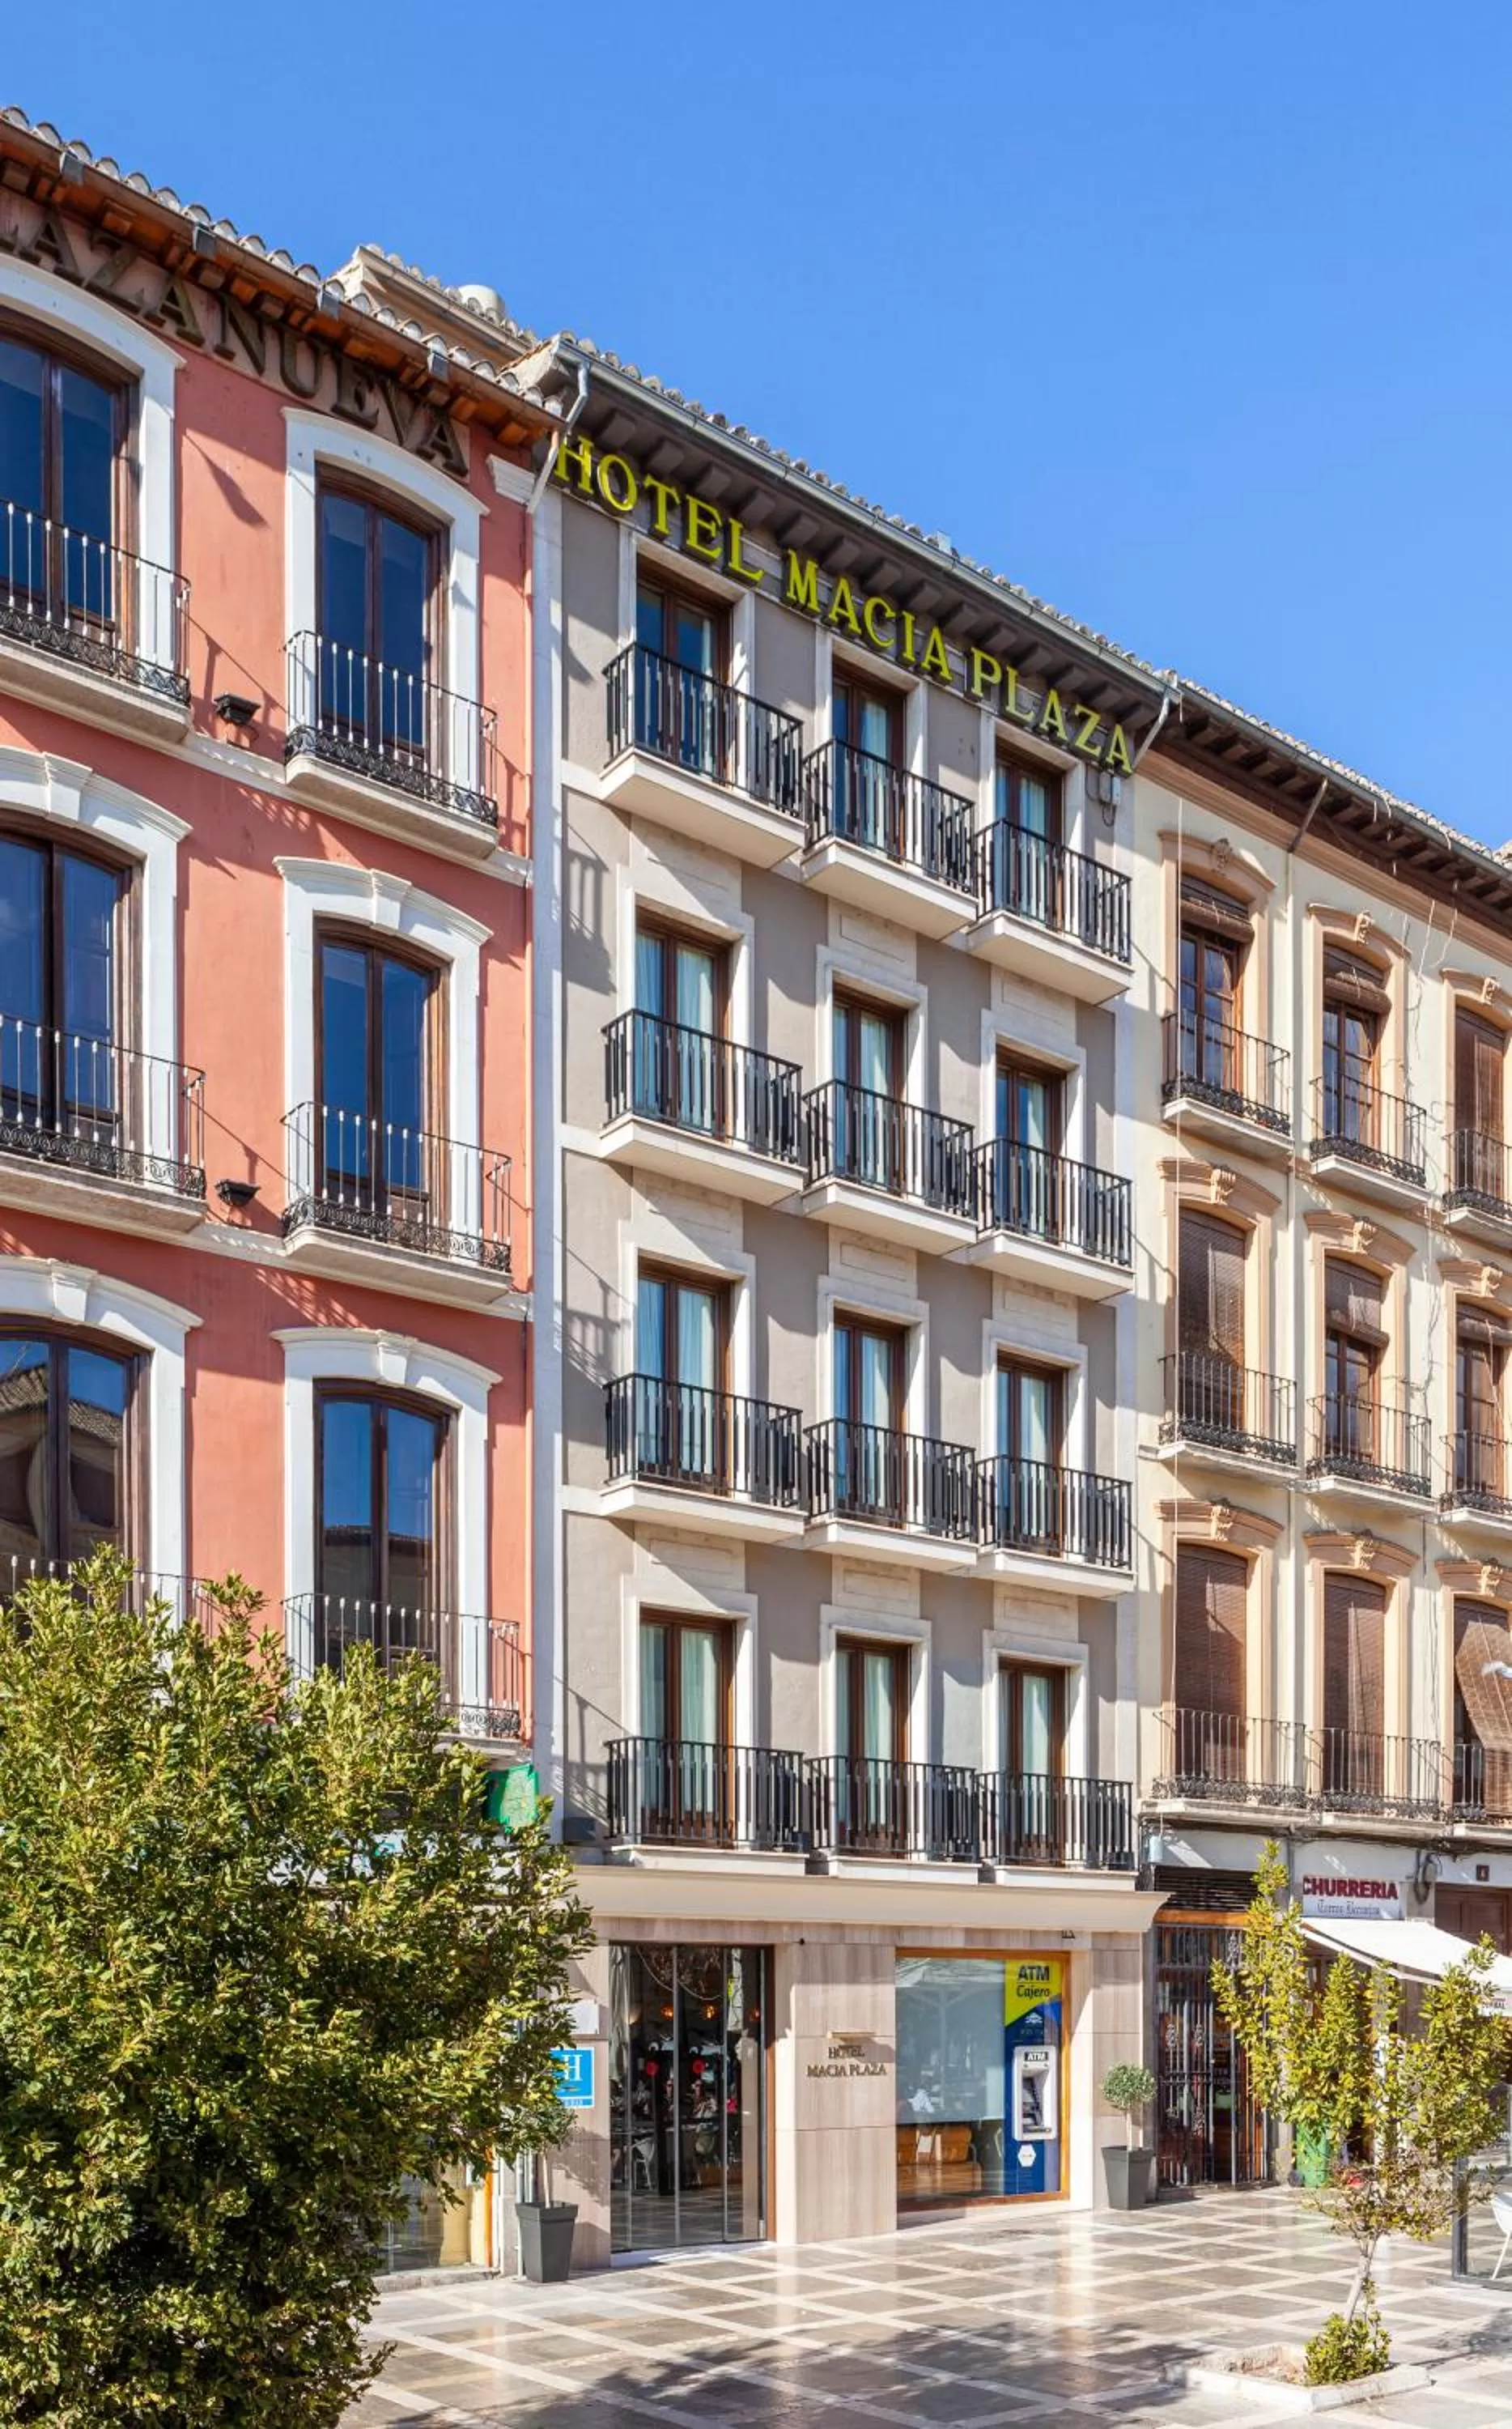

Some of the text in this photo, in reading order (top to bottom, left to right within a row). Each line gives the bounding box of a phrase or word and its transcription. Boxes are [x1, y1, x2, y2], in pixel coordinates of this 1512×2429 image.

[0, 202, 206, 348] AZA
[554, 435, 1132, 773] HOTEL MACIA PLAZA
[1303, 1877, 1399, 1899] CHURRERIA
[1018, 1965, 1050, 1980] ATM
[1017, 1984, 1050, 2000] Cajero
[827, 2045, 865, 2059] HOTEL
[1027, 2052, 1047, 2061] ATM
[562, 2054, 583, 2082] H
[807, 2063, 886, 2078] MACIA PLAZA
